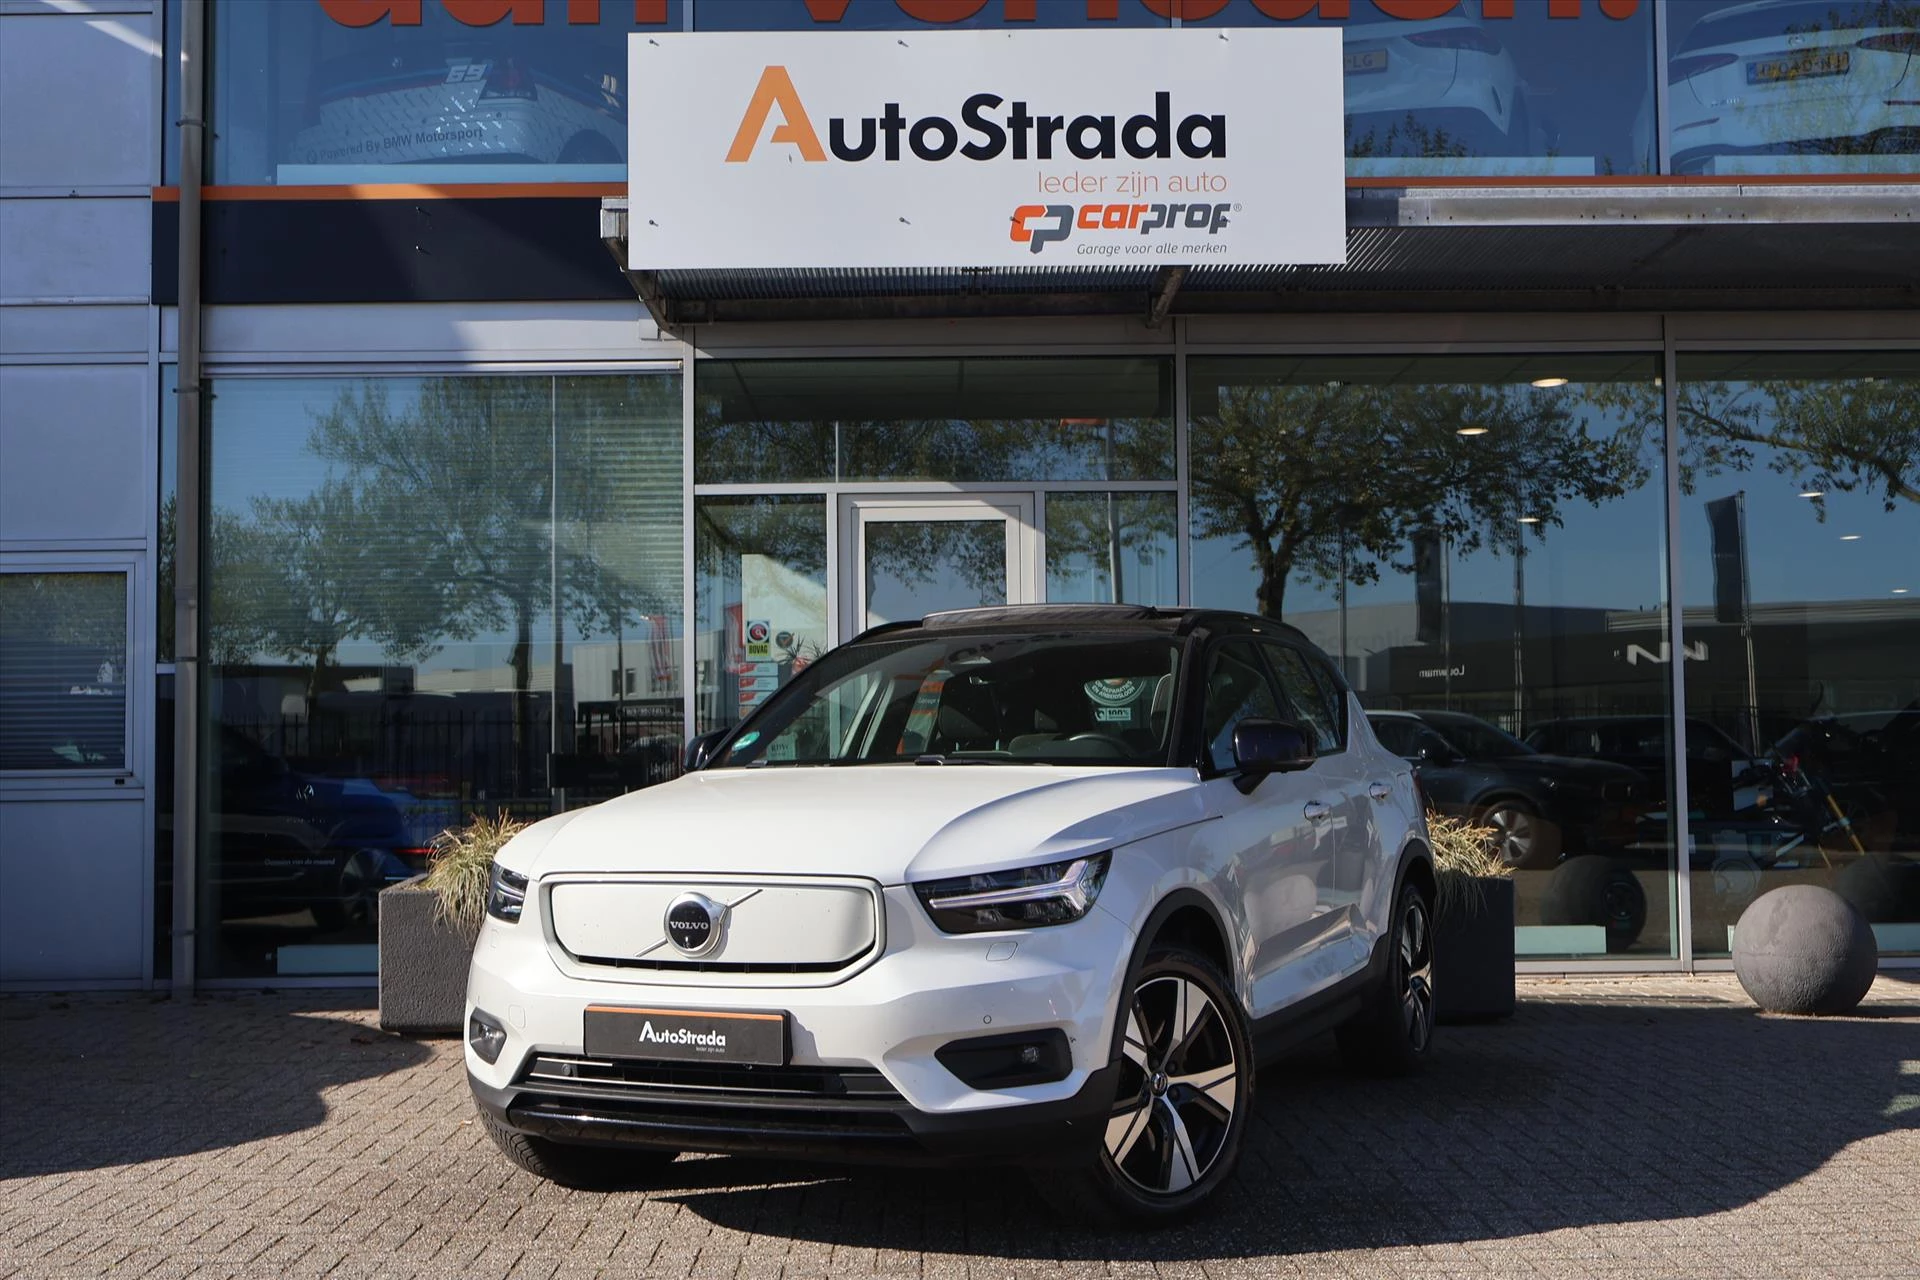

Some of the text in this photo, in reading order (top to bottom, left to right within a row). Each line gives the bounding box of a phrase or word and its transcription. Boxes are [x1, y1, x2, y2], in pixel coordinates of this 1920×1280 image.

[724, 65, 1227, 163] AutoStrada
[366, 140, 381, 154] By
[383, 135, 412, 150] BMW
[415, 127, 484, 145] Motorsport
[1038, 171, 1228, 198] Ieder zijn auto
[1077, 243, 1228, 257] Garage voor alle merken
[670, 920, 709, 930] VOLVO
[639, 1021, 726, 1046] AutoStrada
